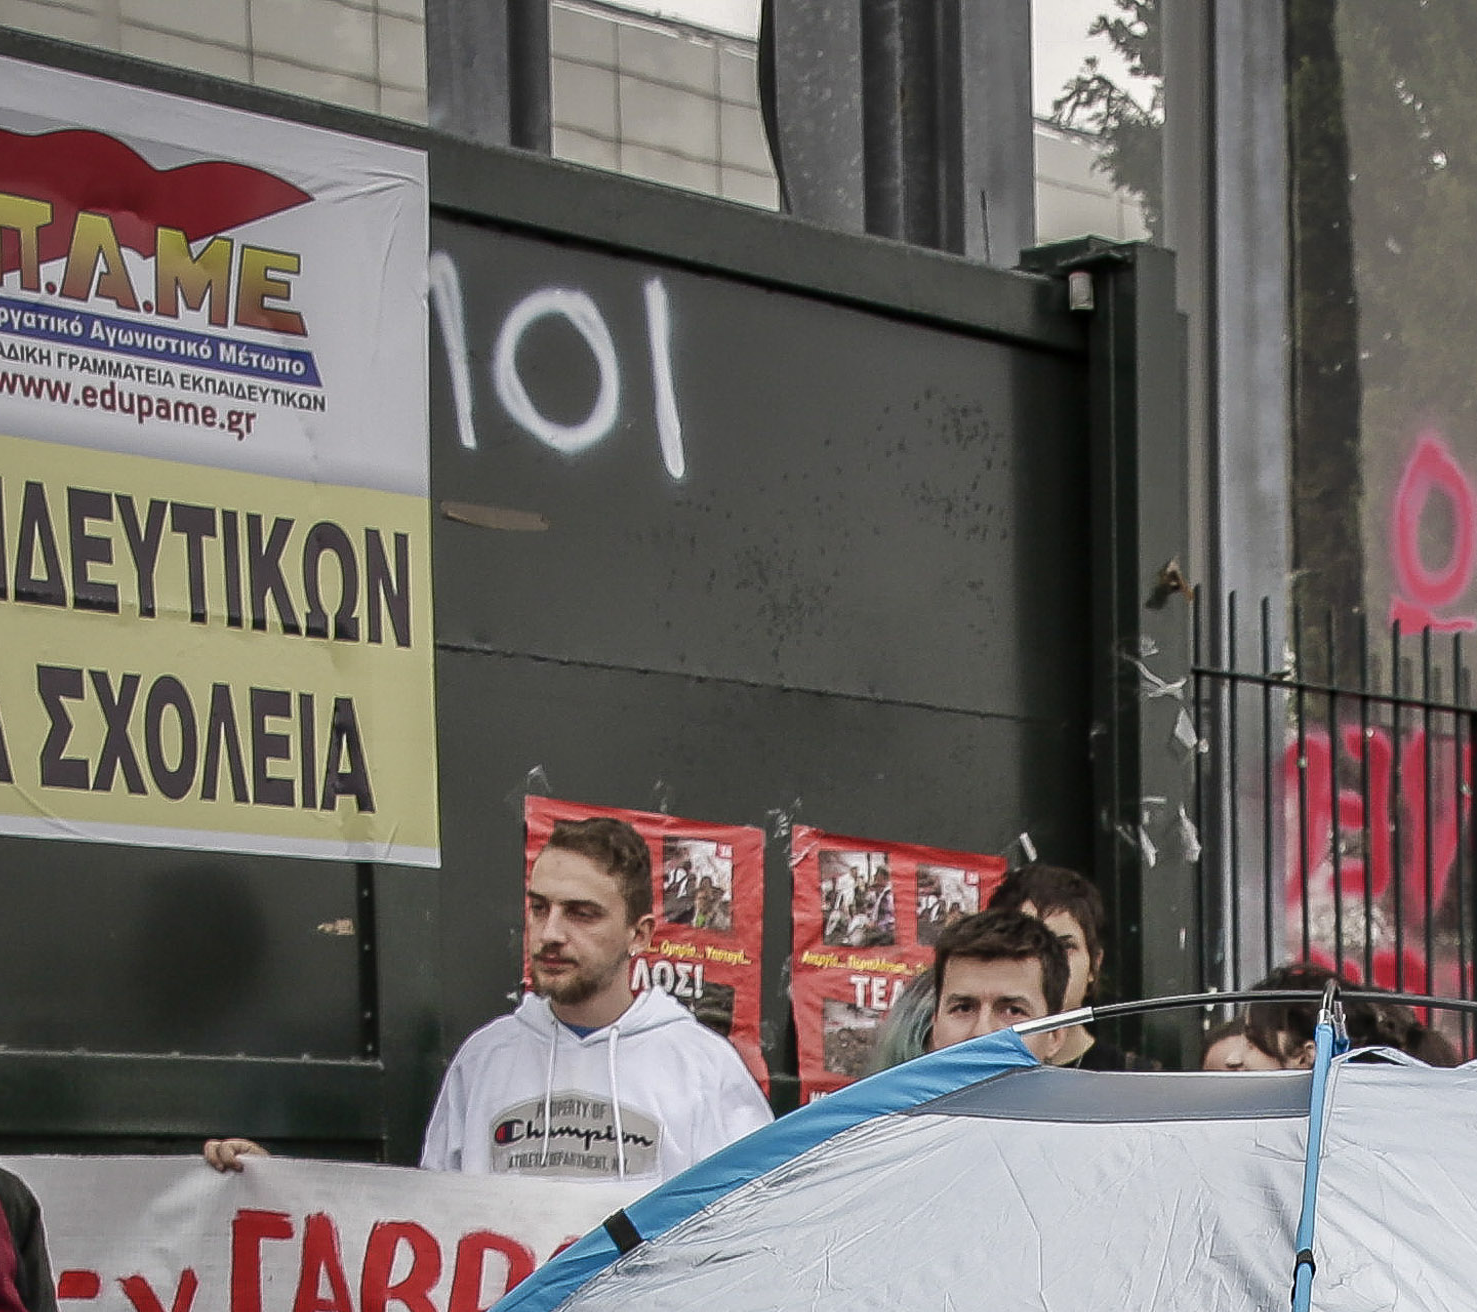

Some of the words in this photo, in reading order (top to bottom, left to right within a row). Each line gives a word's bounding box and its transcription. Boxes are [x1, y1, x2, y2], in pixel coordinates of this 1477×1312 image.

[89, 319, 213, 361] Αγωνιστικό
[218, 342, 307, 377] Μέτωπο
[57, 351, 175, 388] ΓΡΑΜΜΑΤΕΙΑ
[180, 373, 326, 412] ΕΚΠΑΙΔΕΥΤΙΚΩΝ
[37, 664, 376, 814] ΣΧΟΛΕΙΑ
[631, 957, 704, 999] ΛΟΣ!
